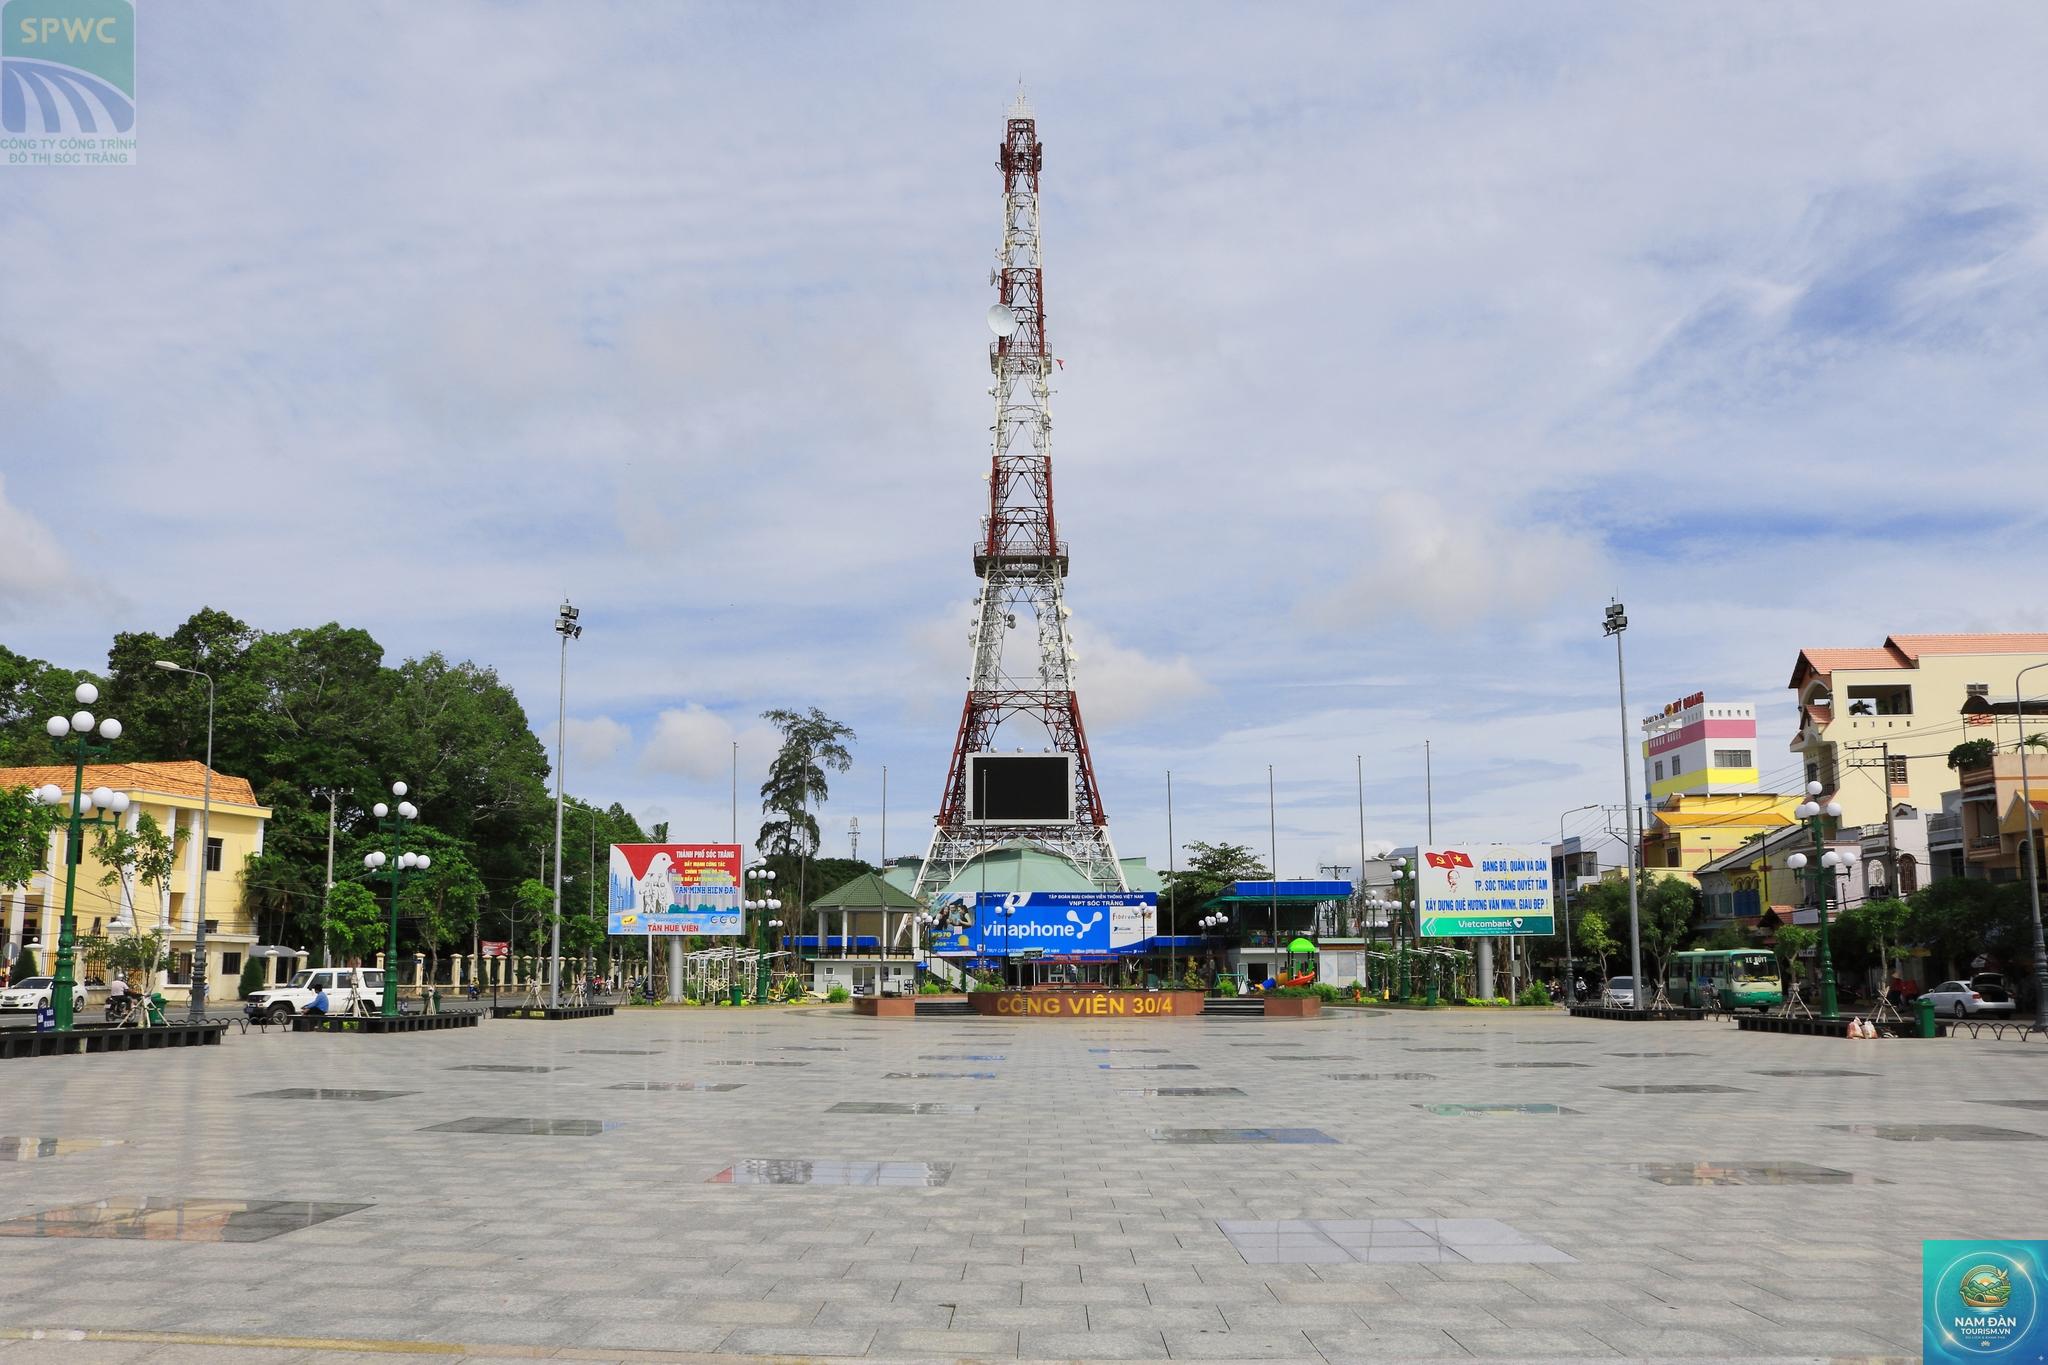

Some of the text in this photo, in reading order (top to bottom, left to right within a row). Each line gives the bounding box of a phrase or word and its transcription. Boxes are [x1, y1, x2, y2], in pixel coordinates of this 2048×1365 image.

[676, 849, 735, 859] THÀNH PHỐ SÓC TRĂNG
[1485, 878, 1496, 891] SÓC
[983, 920, 1075, 939] vinaphone
[1458, 919, 1512, 928] Vietcombank
[997, 994, 1172, 1014] CÔNG VIÊN 30/4
